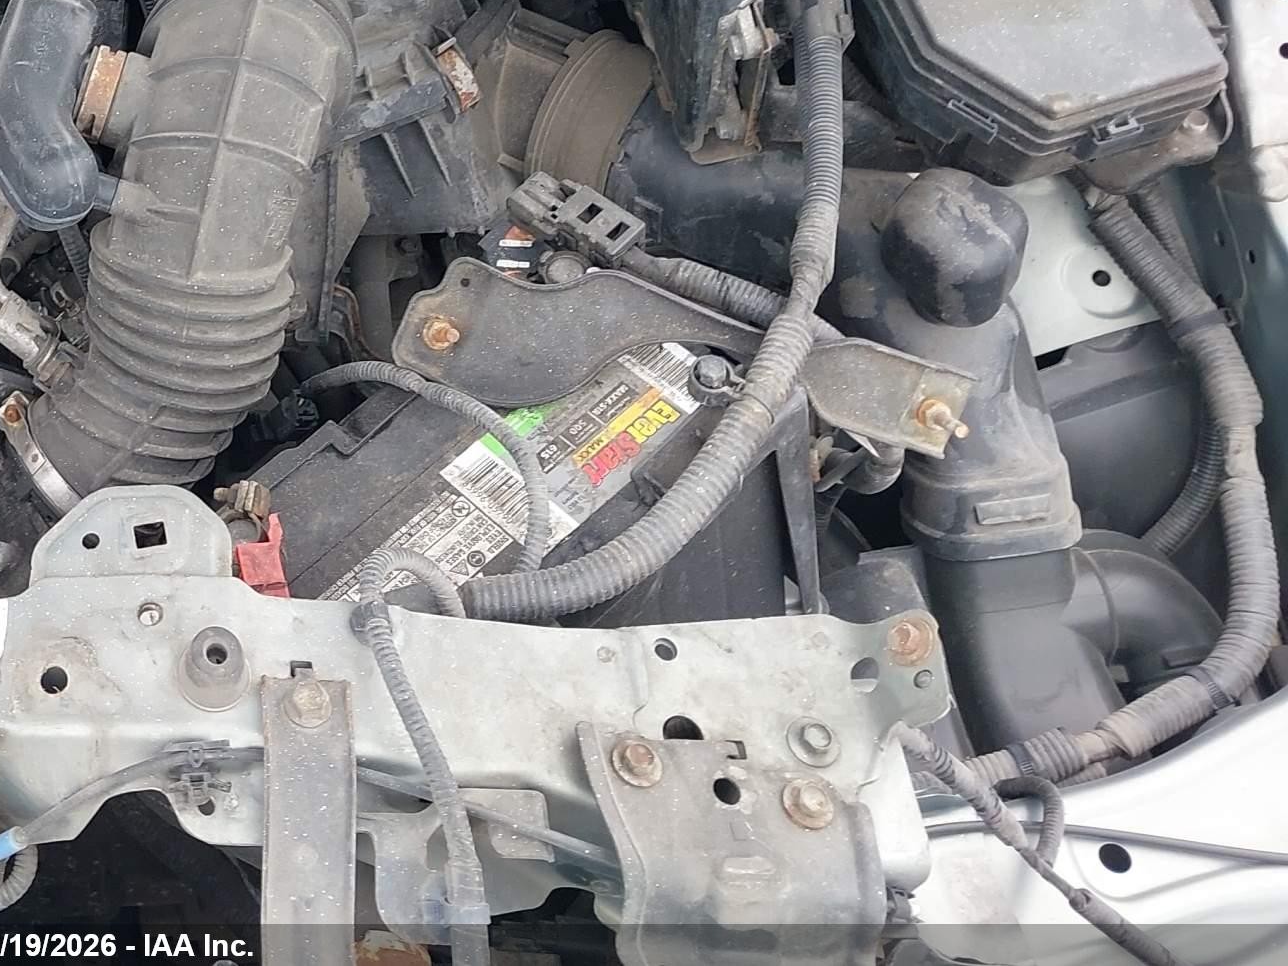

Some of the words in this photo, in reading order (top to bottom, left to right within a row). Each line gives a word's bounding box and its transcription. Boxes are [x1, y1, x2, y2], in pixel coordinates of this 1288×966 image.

[566, 418, 587, 436] 500
[538, 442, 559, 460] 615
[576, 436, 605, 462] MAXX
[579, 398, 681, 489] EverStart
